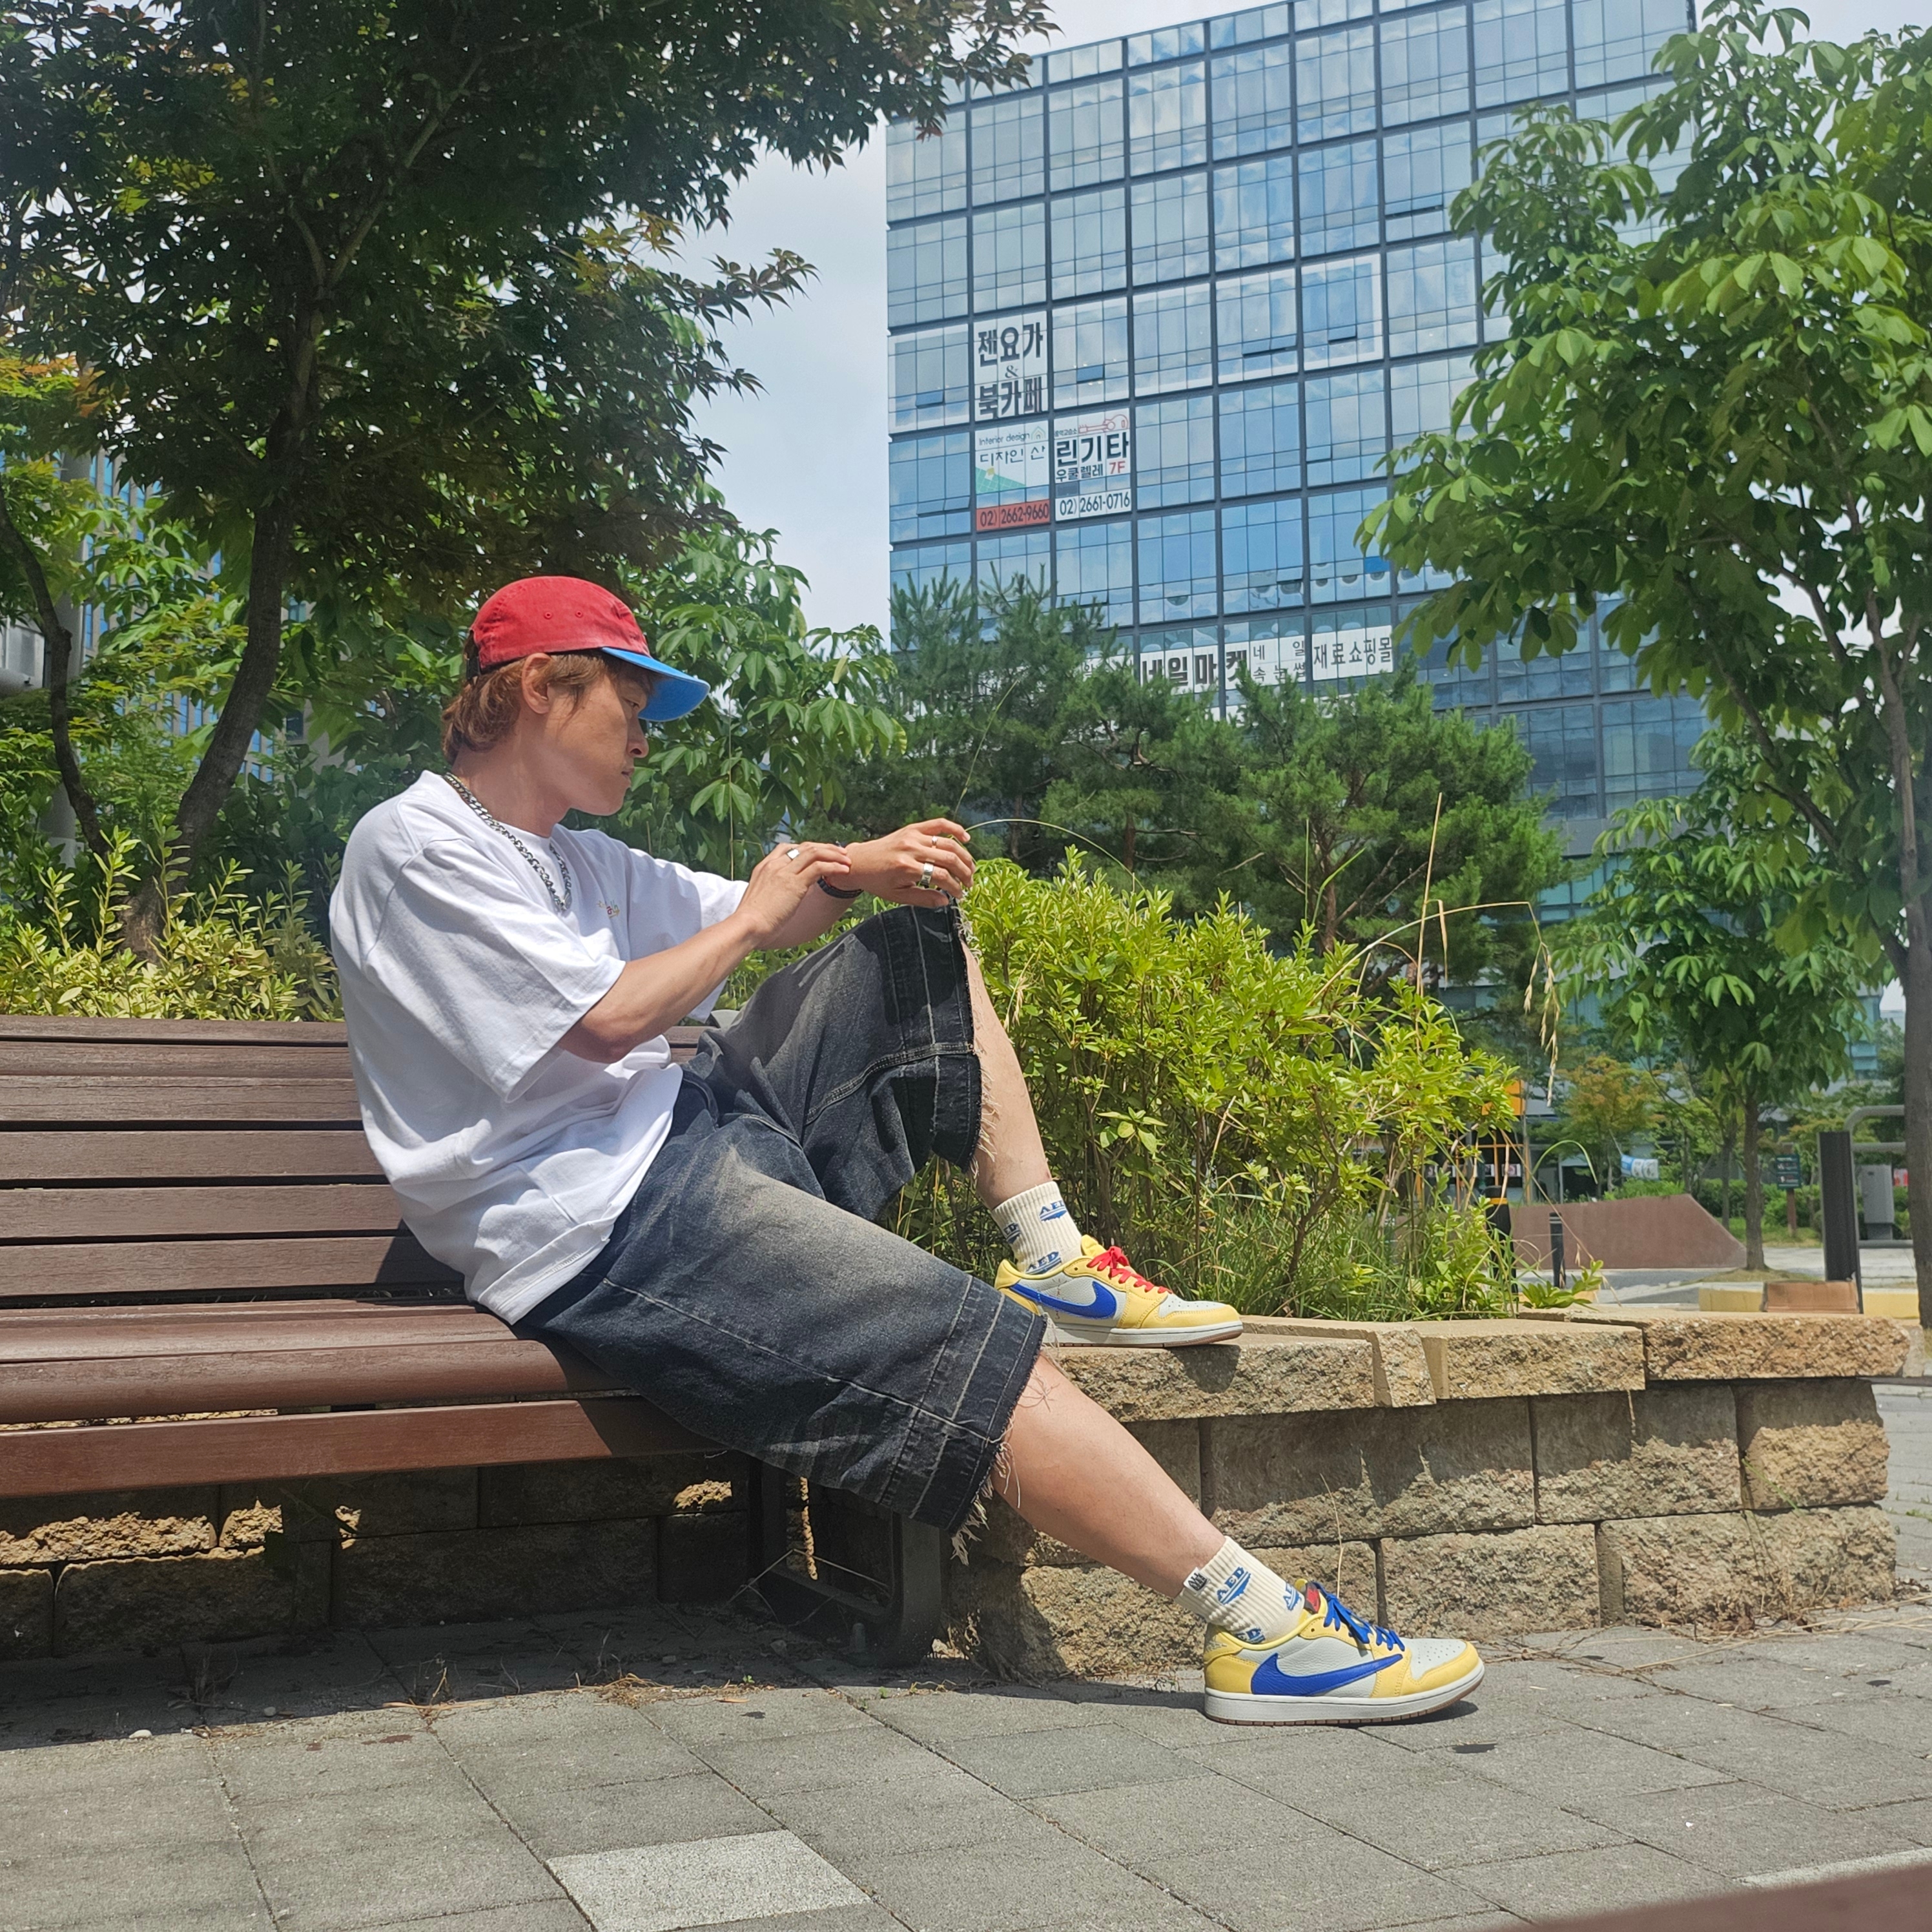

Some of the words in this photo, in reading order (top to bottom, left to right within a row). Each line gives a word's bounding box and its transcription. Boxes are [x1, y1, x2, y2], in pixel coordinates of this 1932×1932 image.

[978, 322, 1043, 367] 젠요가
[1005, 365, 1018, 378] &
[979, 376, 1043, 419] 북카페
[1006, 432, 1030, 442] design
[980, 449, 1023, 466] 디자인
[1031, 446, 1045, 460] 산
[1056, 432, 1129, 467] 린기타
[1056, 464, 1104, 482] 우쿨렐레
[1109, 461, 1125, 474] 7F
[980, 510, 997, 527] 02)
[1002, 503, 1049, 524] 2662-9660
[1060, 498, 1078, 516] 02)
[1080, 492, 1130, 513] 2661-0716
[1026, 1251, 1059, 1271] AED
[1217, 1567, 1245, 1601] AED
